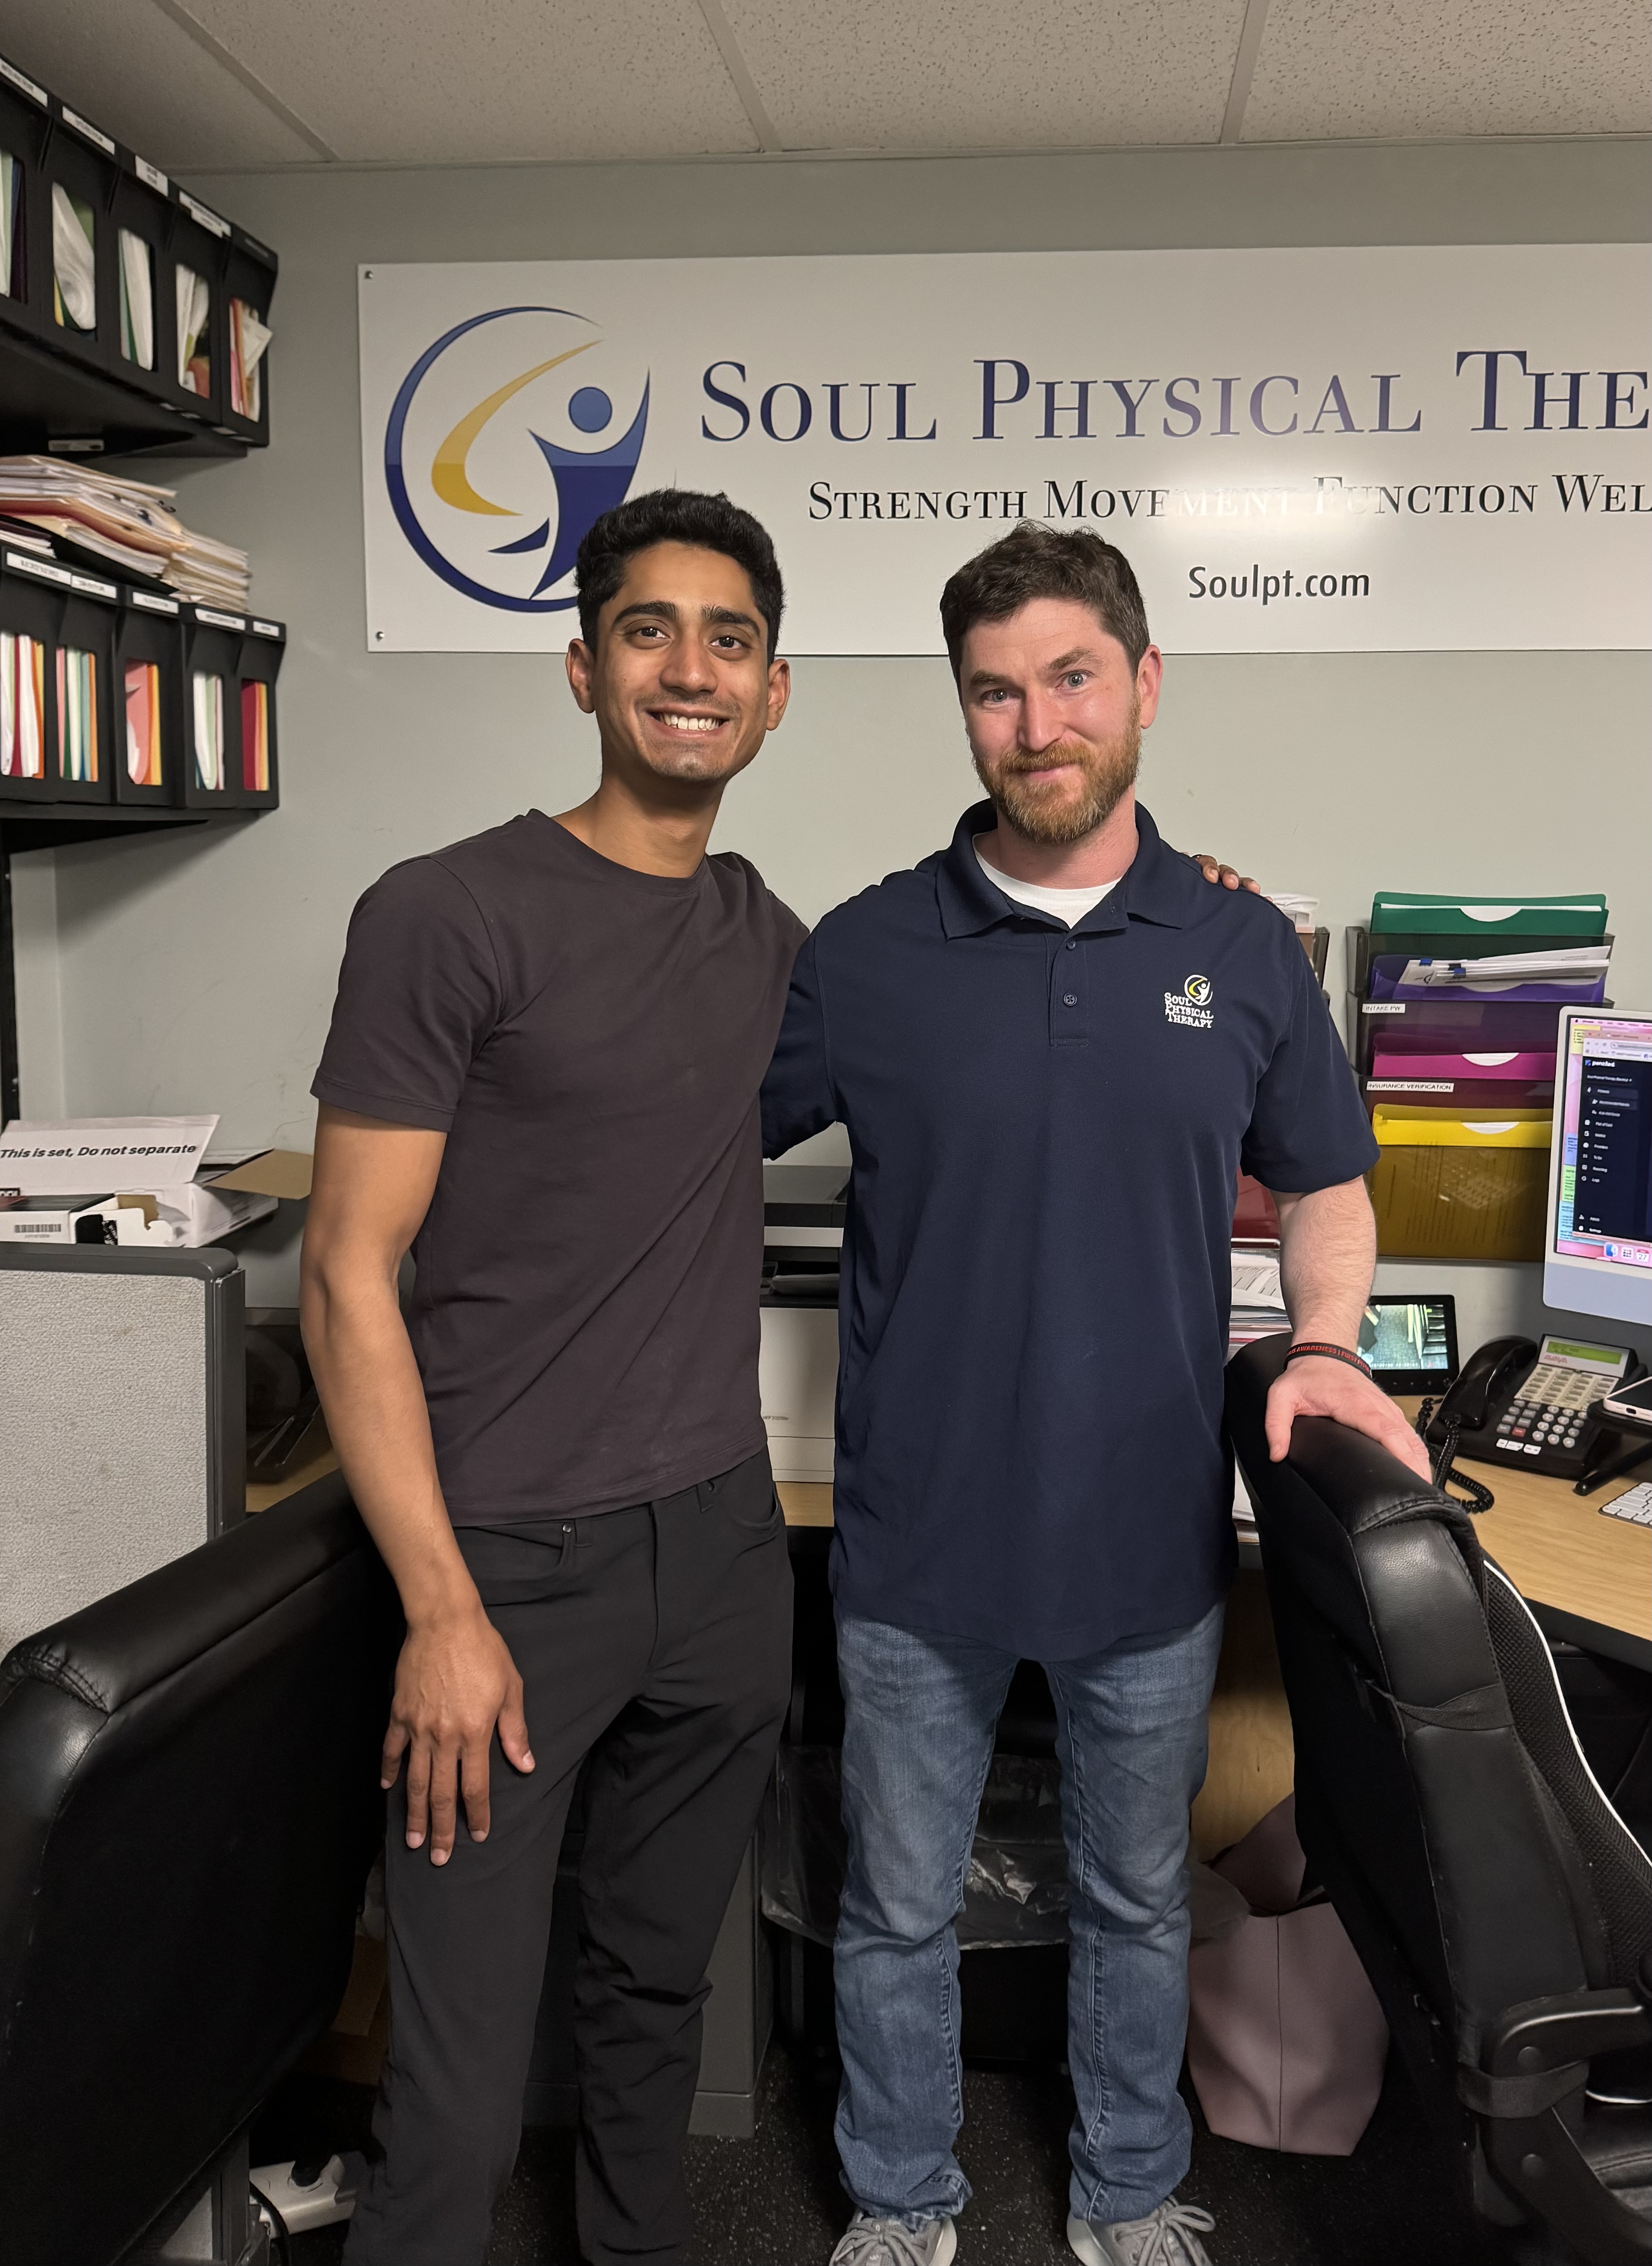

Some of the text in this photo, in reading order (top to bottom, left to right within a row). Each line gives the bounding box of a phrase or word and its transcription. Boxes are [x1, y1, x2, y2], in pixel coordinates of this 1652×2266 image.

[701, 360, 937, 442] SOUL
[973, 359, 1421, 439] PHYSICAL
[808, 481, 1027, 520] STRENGTH
[1313, 476, 1538, 515] FUNCTION
[1189, 564, 1370, 606] Soulpt.com
[1164, 992, 1192, 1007] SOUL
[1165, 1001, 1214, 1019] PHYSICAL
[1165, 1010, 1213, 1028] THERAPY
[0, 1145, 197, 1158] This is set, Do not separate
[1297, 1346, 1337, 1354] AWARENESS
